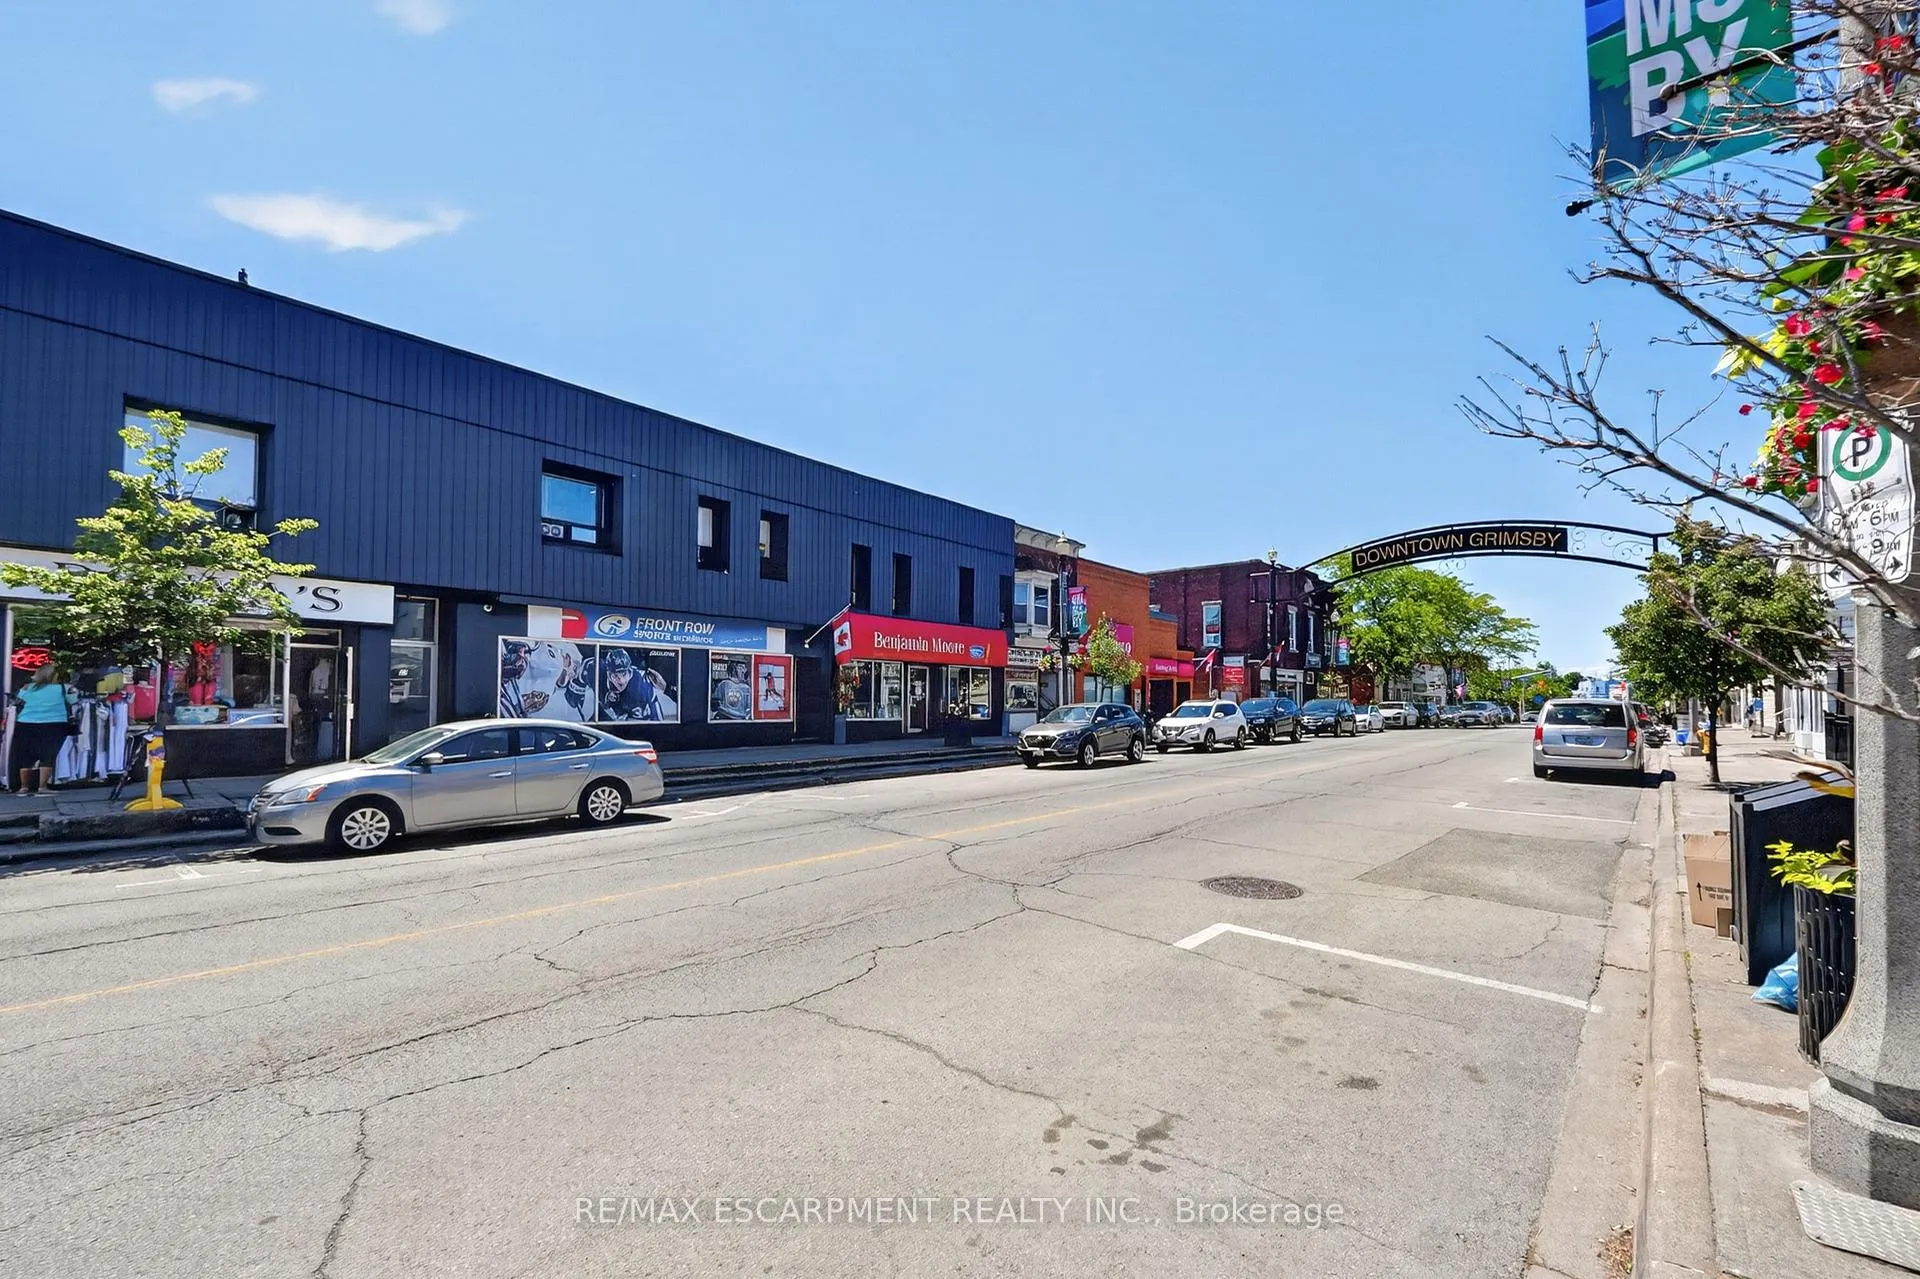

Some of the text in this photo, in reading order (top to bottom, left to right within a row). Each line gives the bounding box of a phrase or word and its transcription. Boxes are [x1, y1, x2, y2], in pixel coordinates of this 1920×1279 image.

[1629, 17, 1749, 138] BY
[1852, 437, 1874, 467] P
[1355, 531, 1561, 567] DOWNTOWN GRIMSBY
[636, 617, 716, 635] FRONT ROW
[874, 631, 965, 655] Benjamin Moore
